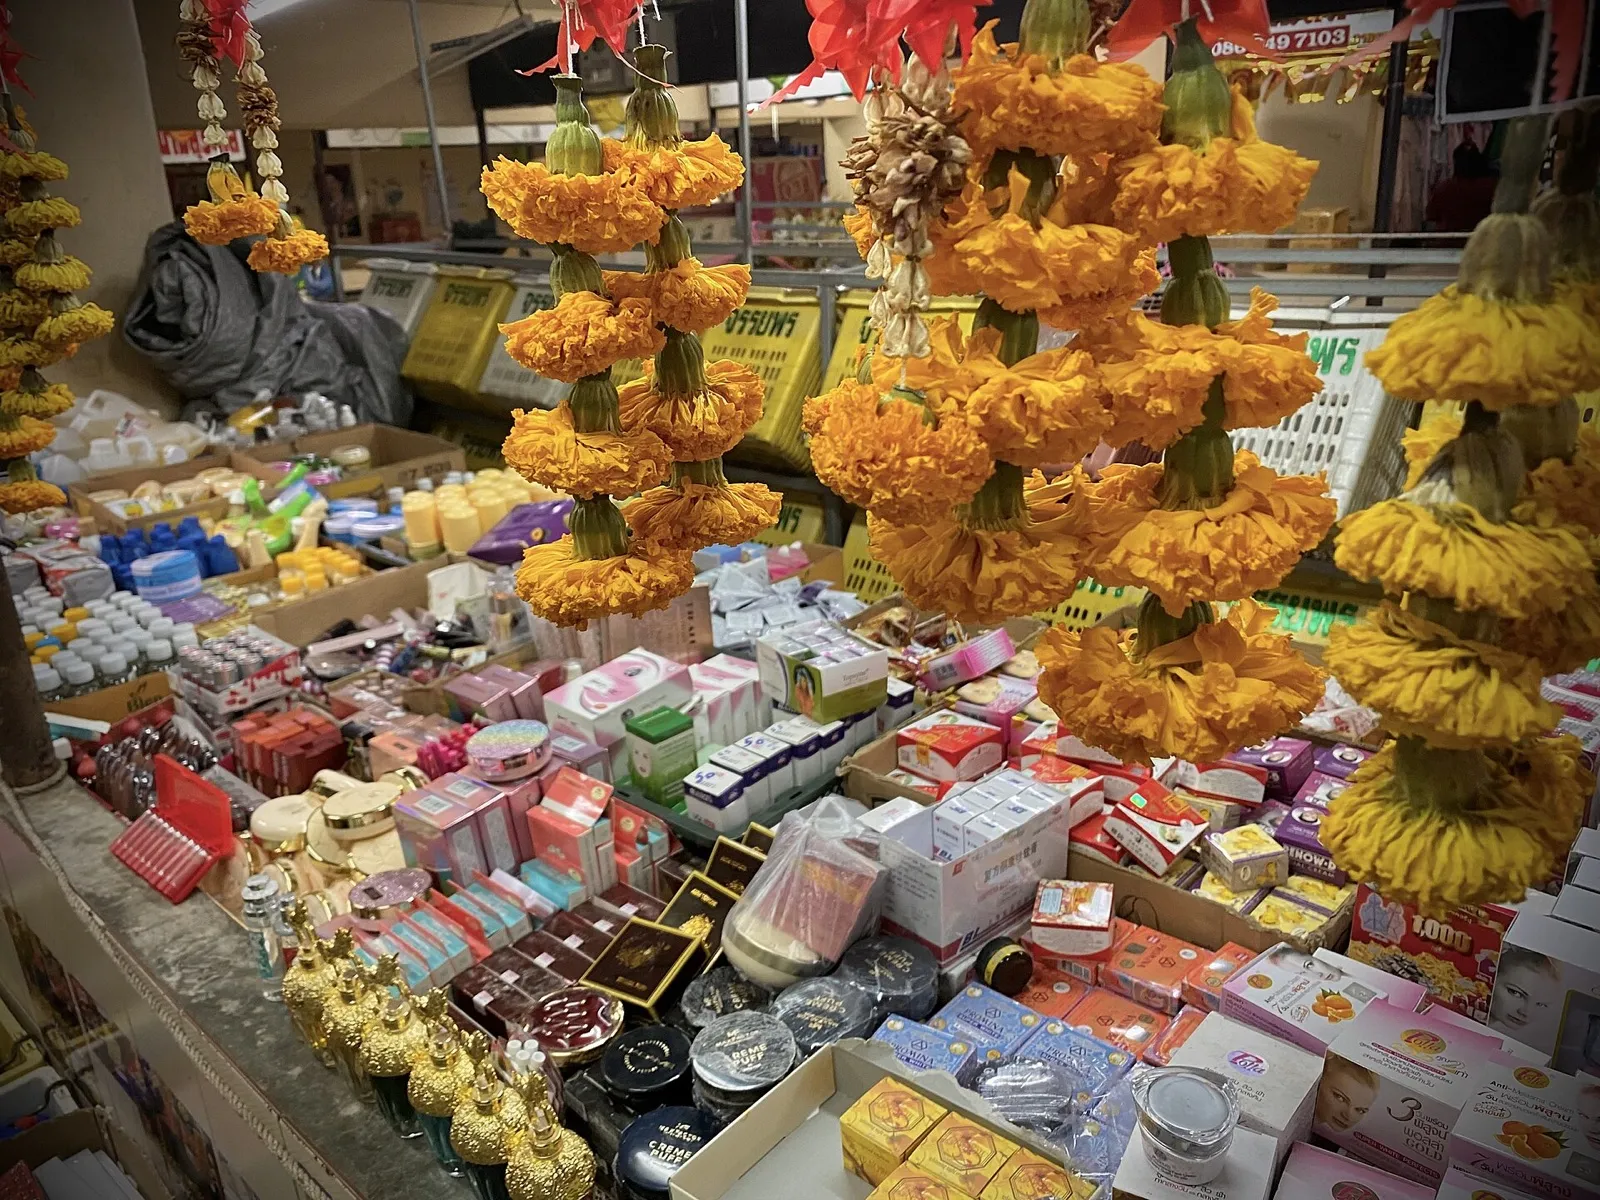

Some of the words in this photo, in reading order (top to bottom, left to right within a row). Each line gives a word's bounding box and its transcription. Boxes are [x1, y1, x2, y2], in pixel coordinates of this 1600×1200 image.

[1295, 28, 1346, 49] 7103
[1412, 914, 1473, 954] 1,000
[1230, 1052, 1266, 1074] Polla
[1387, 1097, 1422, 1121] 3
[648, 1140, 692, 1159] CREME
[649, 1149, 683, 1164] PUFF
[1406, 1139, 1442, 1161] GOLD
